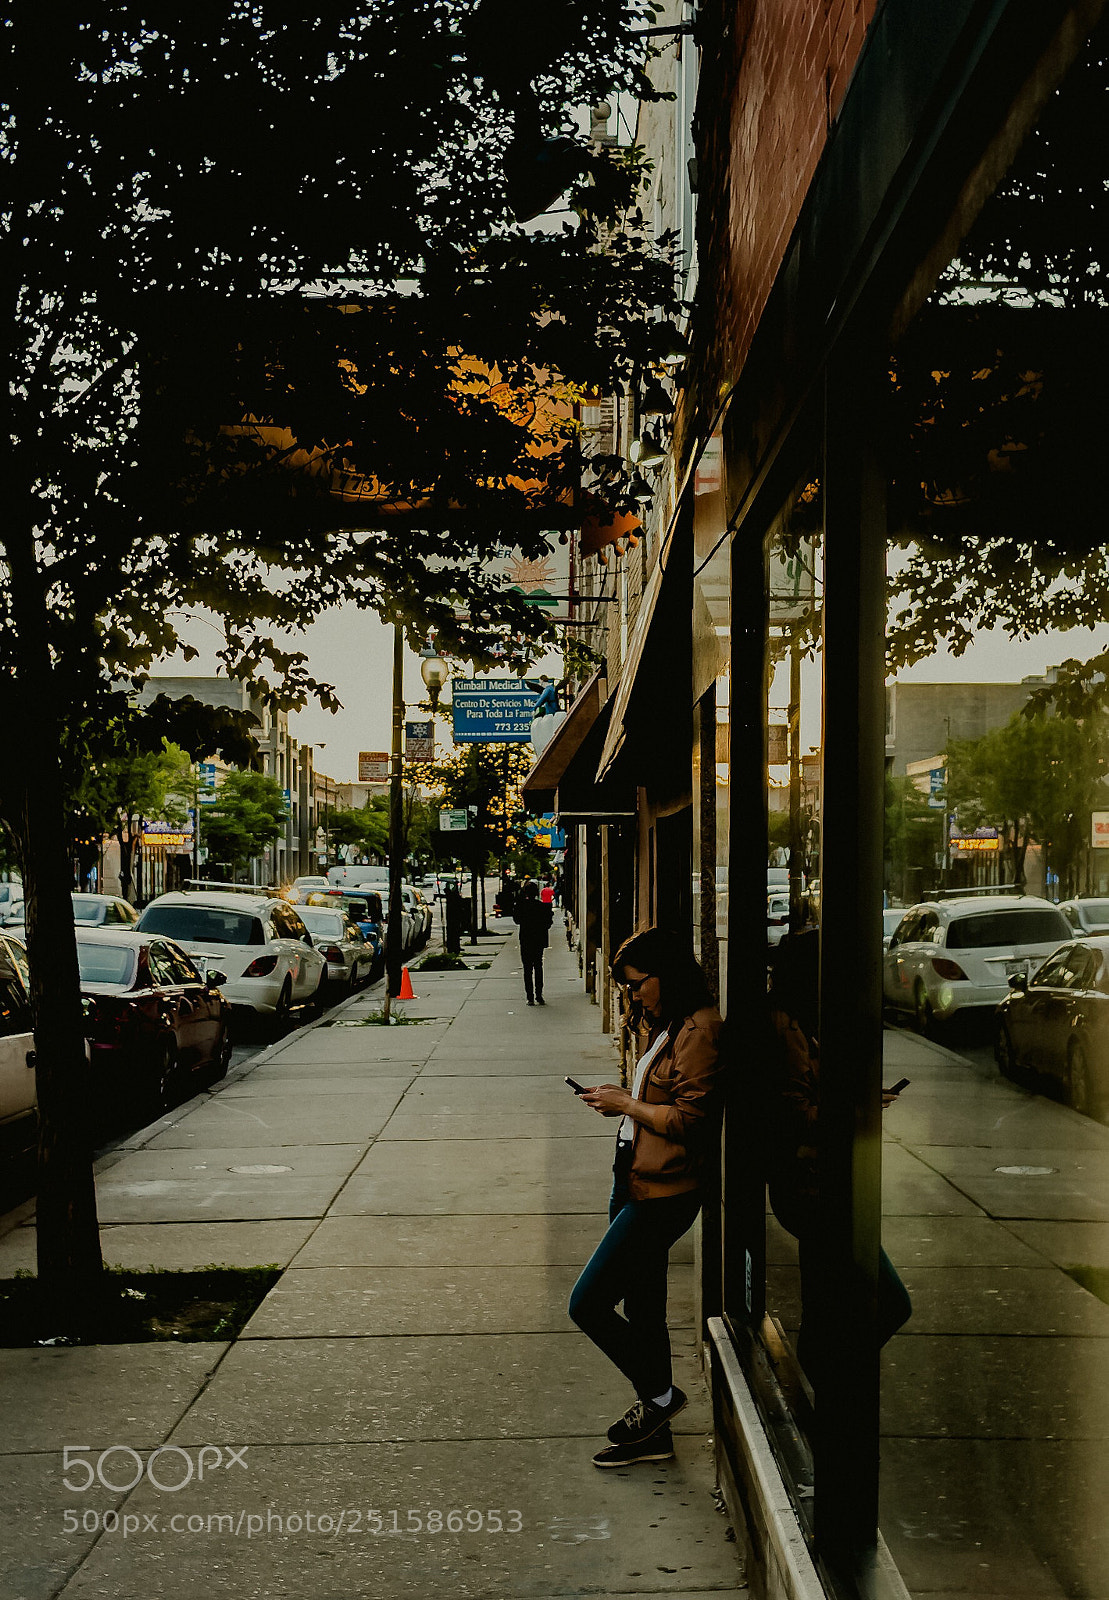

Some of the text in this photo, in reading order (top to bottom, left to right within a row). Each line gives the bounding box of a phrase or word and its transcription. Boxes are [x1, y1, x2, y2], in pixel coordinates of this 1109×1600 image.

[454, 680, 486, 691] Kimball
[488, 679, 523, 691] Medical
[454, 699, 479, 709] Centro
[479, 698, 491, 709] De
[491, 698, 522, 709] Servicios
[466, 709, 483, 719] Para
[484, 708, 503, 719] Toda
[504, 708, 514, 718] La
[494, 723, 530, 732] 773 235
